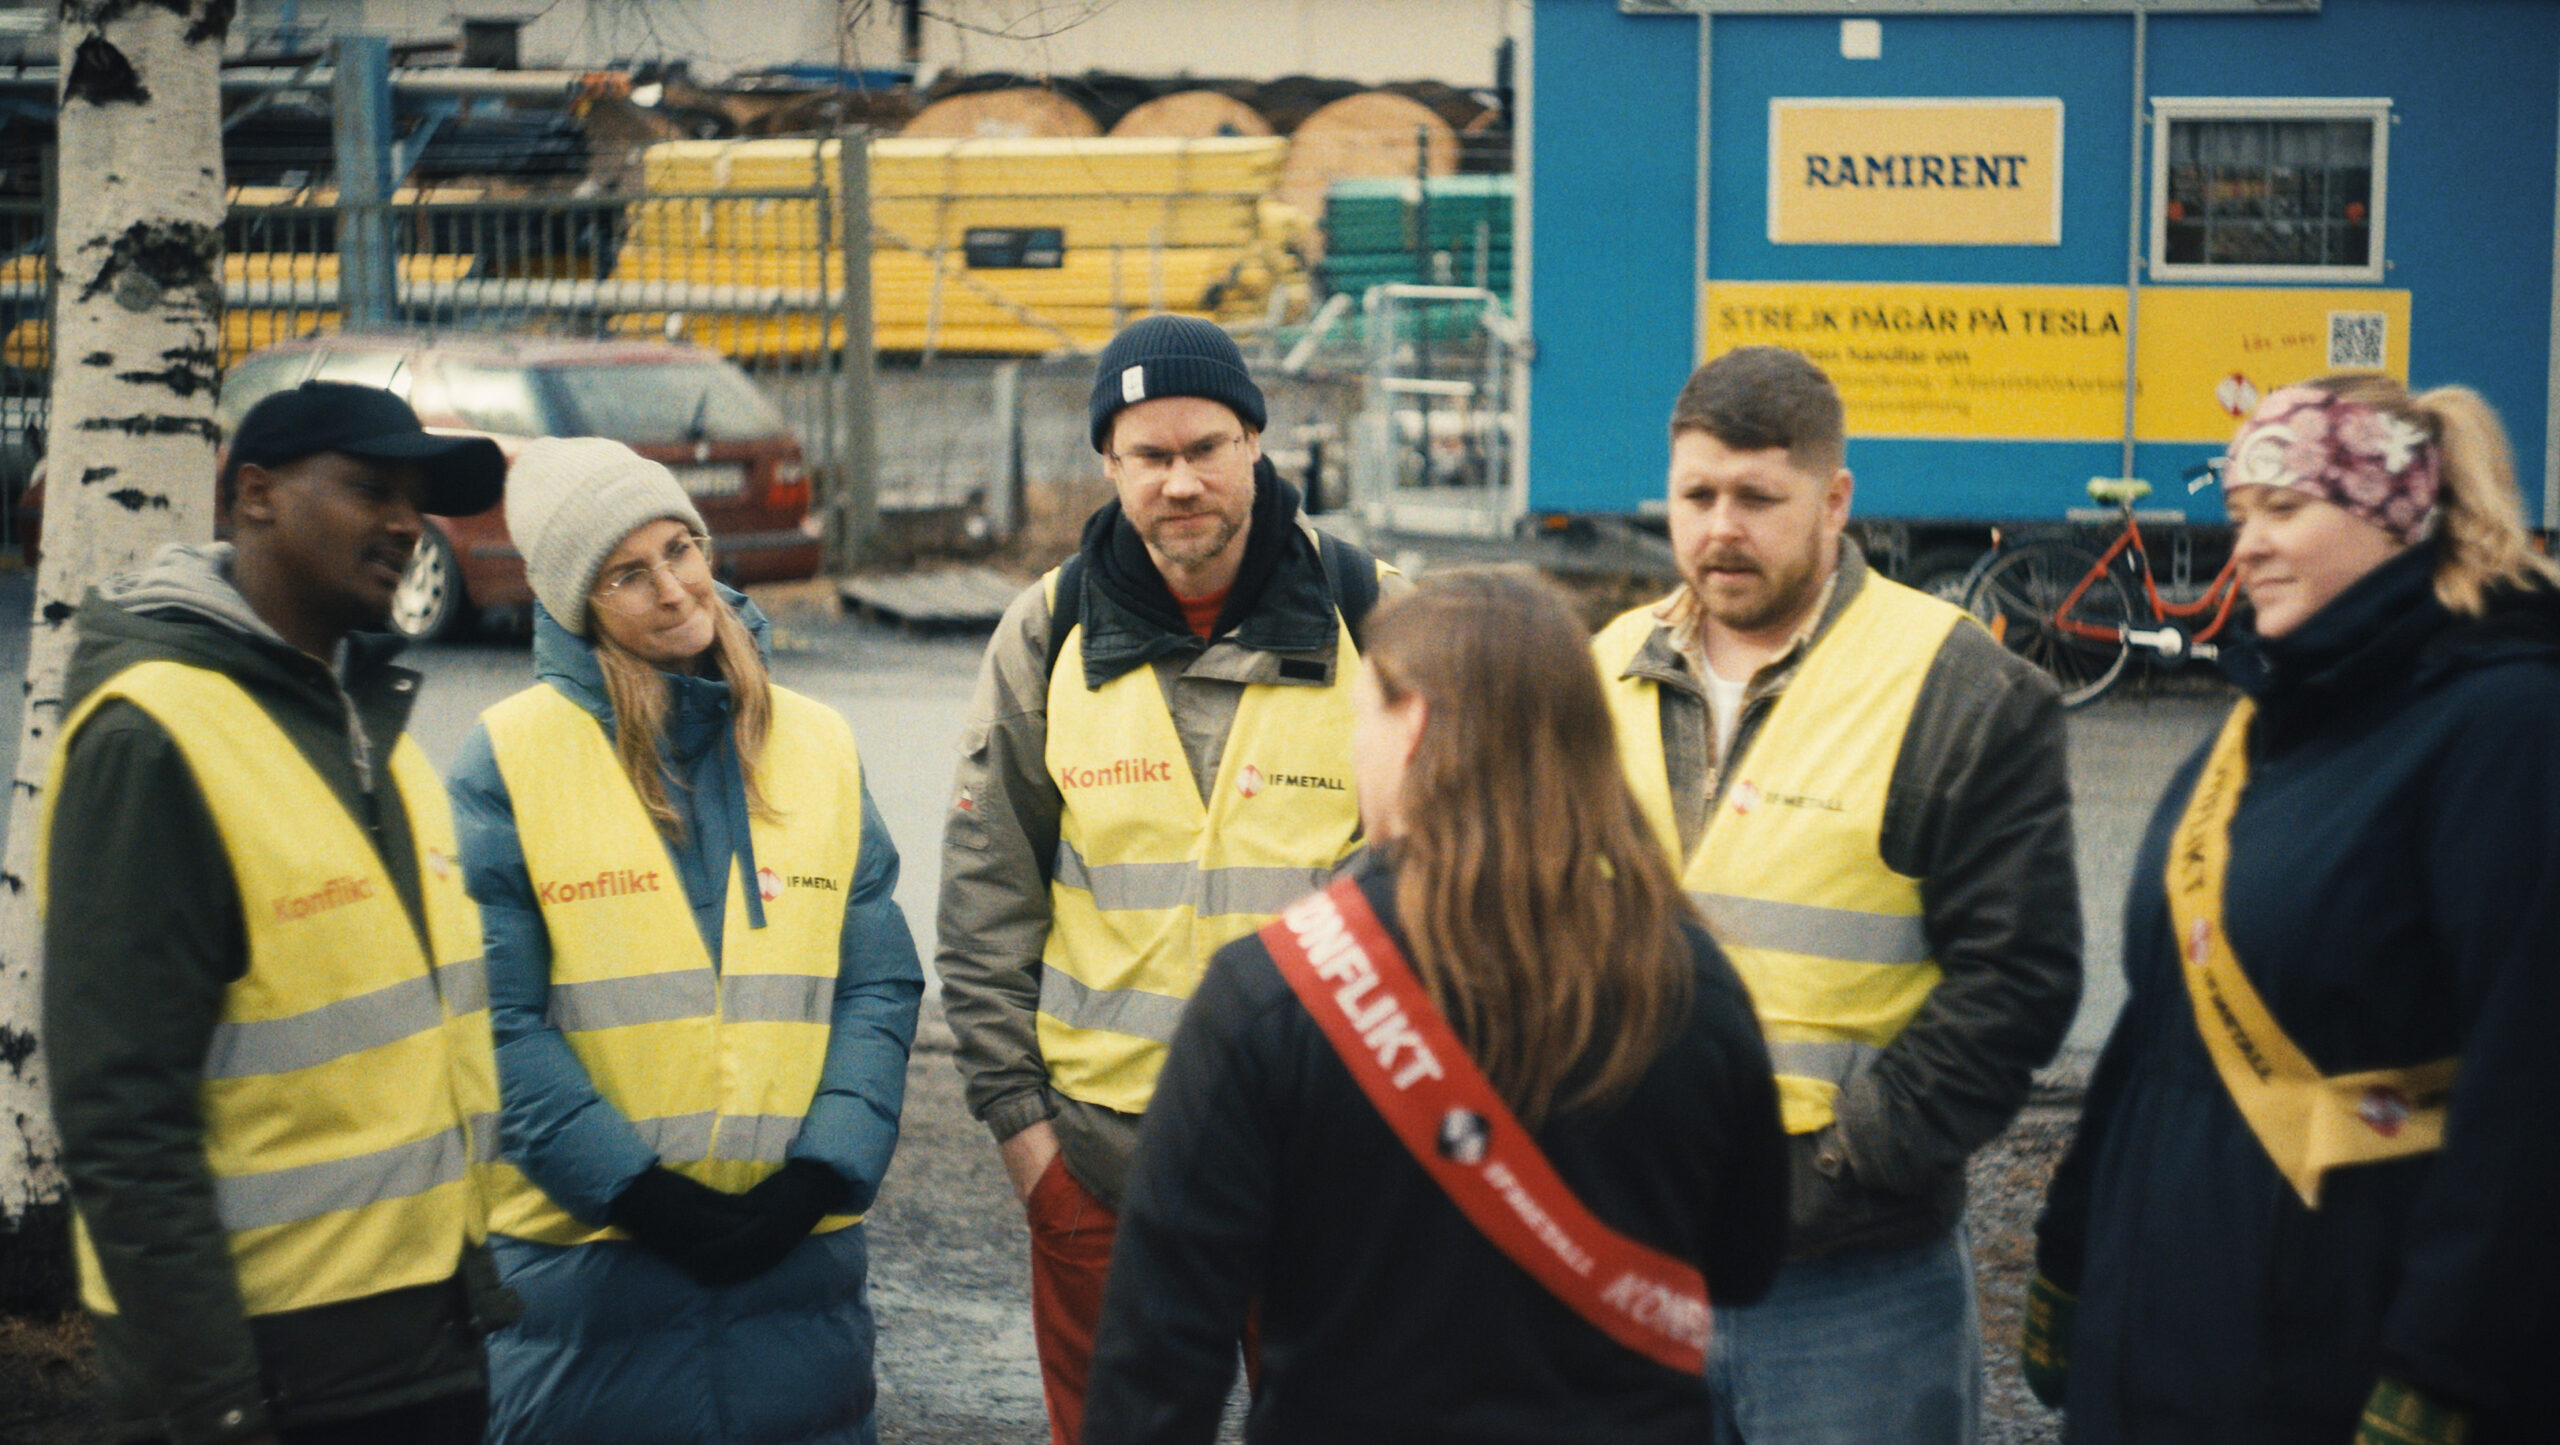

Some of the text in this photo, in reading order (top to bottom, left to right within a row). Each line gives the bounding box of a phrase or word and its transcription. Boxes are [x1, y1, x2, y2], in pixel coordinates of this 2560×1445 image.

[1804, 154, 2028, 188] RAMIRENT
[1720, 303, 2121, 336] STREJK PÅGÅR PÅ TESLA
[1061, 758, 1172, 790] Konflikt
[1269, 774, 1346, 791] IF METALL
[270, 875, 375, 925] Konflikt
[540, 868, 660, 906] Konflikt
